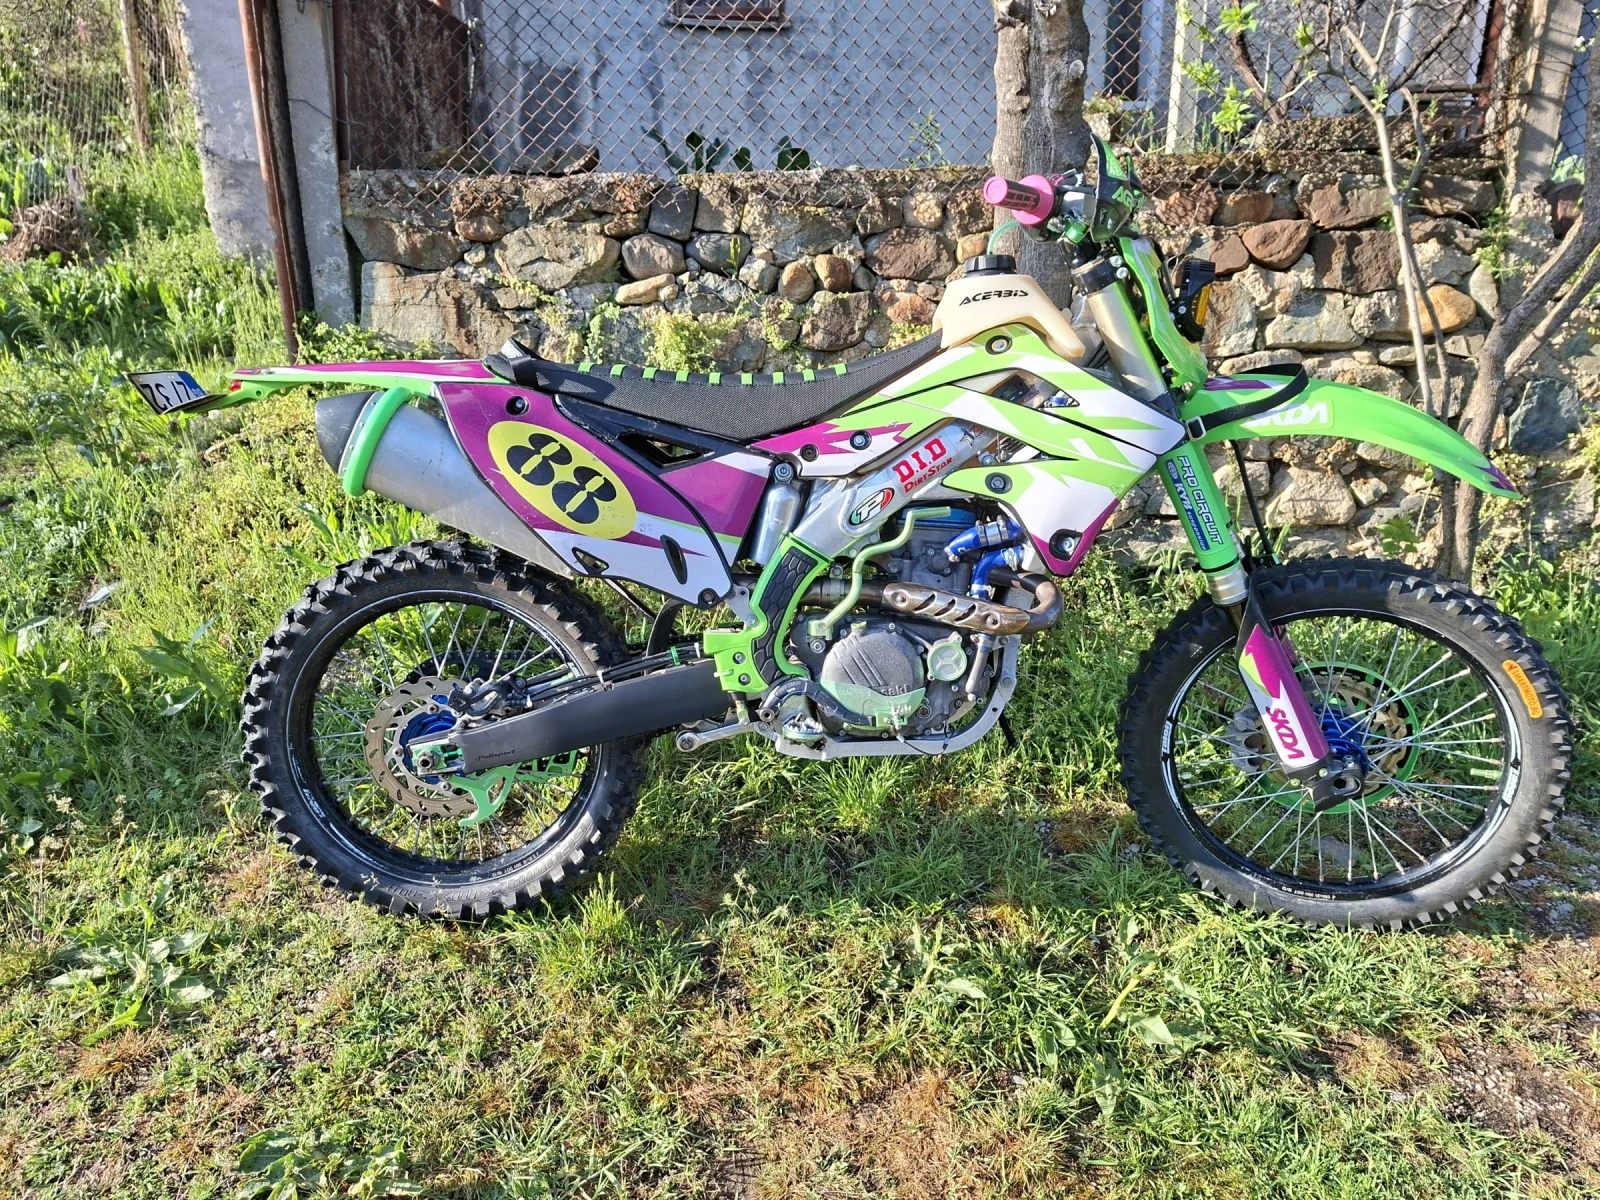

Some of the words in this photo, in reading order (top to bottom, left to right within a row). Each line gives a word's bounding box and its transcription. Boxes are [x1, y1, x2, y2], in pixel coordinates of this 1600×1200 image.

[959, 288, 1029, 306] ACERBIS
[506, 432, 617, 525] 88
[891, 437, 947, 484] D.I.D
[1177, 455, 1198, 488] PRO
[1174, 482, 1193, 511] KYB
[1192, 488, 1224, 545] CIRCUIT
[1265, 705, 1306, 760] SKDA
